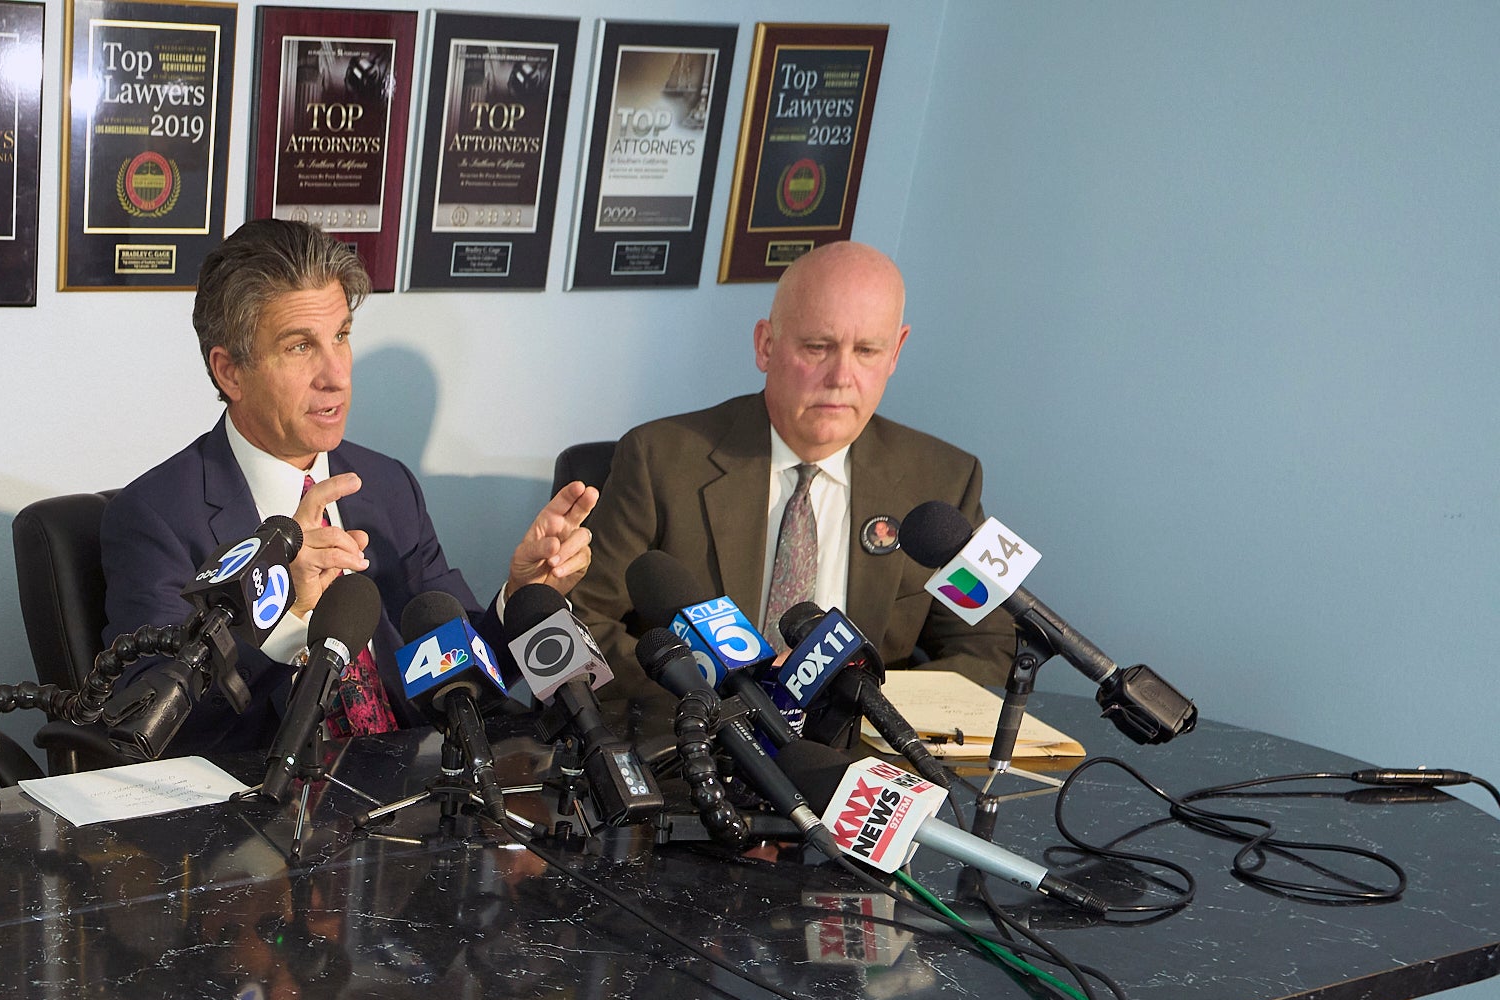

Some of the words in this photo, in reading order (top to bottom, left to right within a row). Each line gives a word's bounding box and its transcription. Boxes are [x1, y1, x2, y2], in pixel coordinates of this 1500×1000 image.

[103, 42, 153, 79] Top
[159, 53, 193, 62] EXCELLENCE
[194, 54, 206, 63] AND
[162, 62, 206, 72] ACHIEVEMENTS
[103, 75, 205, 112] Lawyers
[781, 63, 818, 96] Top
[306, 103, 364, 132] TOP
[470, 102, 525, 131] TOP
[617, 107, 672, 136] TOP
[775, 92, 854, 124] Lawyers
[150, 114, 205, 143] 2019
[285, 133, 380, 153] ATTORNEYS
[449, 132, 540, 153] ATTORNEYS
[807, 125, 852, 145] 2023
[612, 139, 695, 156] ATTORNEYS
[978, 534, 1023, 577] 34
[195, 568, 218, 581] abc
[251, 567, 264, 597] abc
[685, 597, 734, 621] KTLA
[707, 614, 761, 662] 5
[404, 635, 447, 684] 4
[786, 640, 834, 701] FOX
[824, 621, 855, 653] 11
[831, 776, 884, 849] KNX
[898, 798, 912, 813] FM
[851, 788, 901, 858] NEWS
